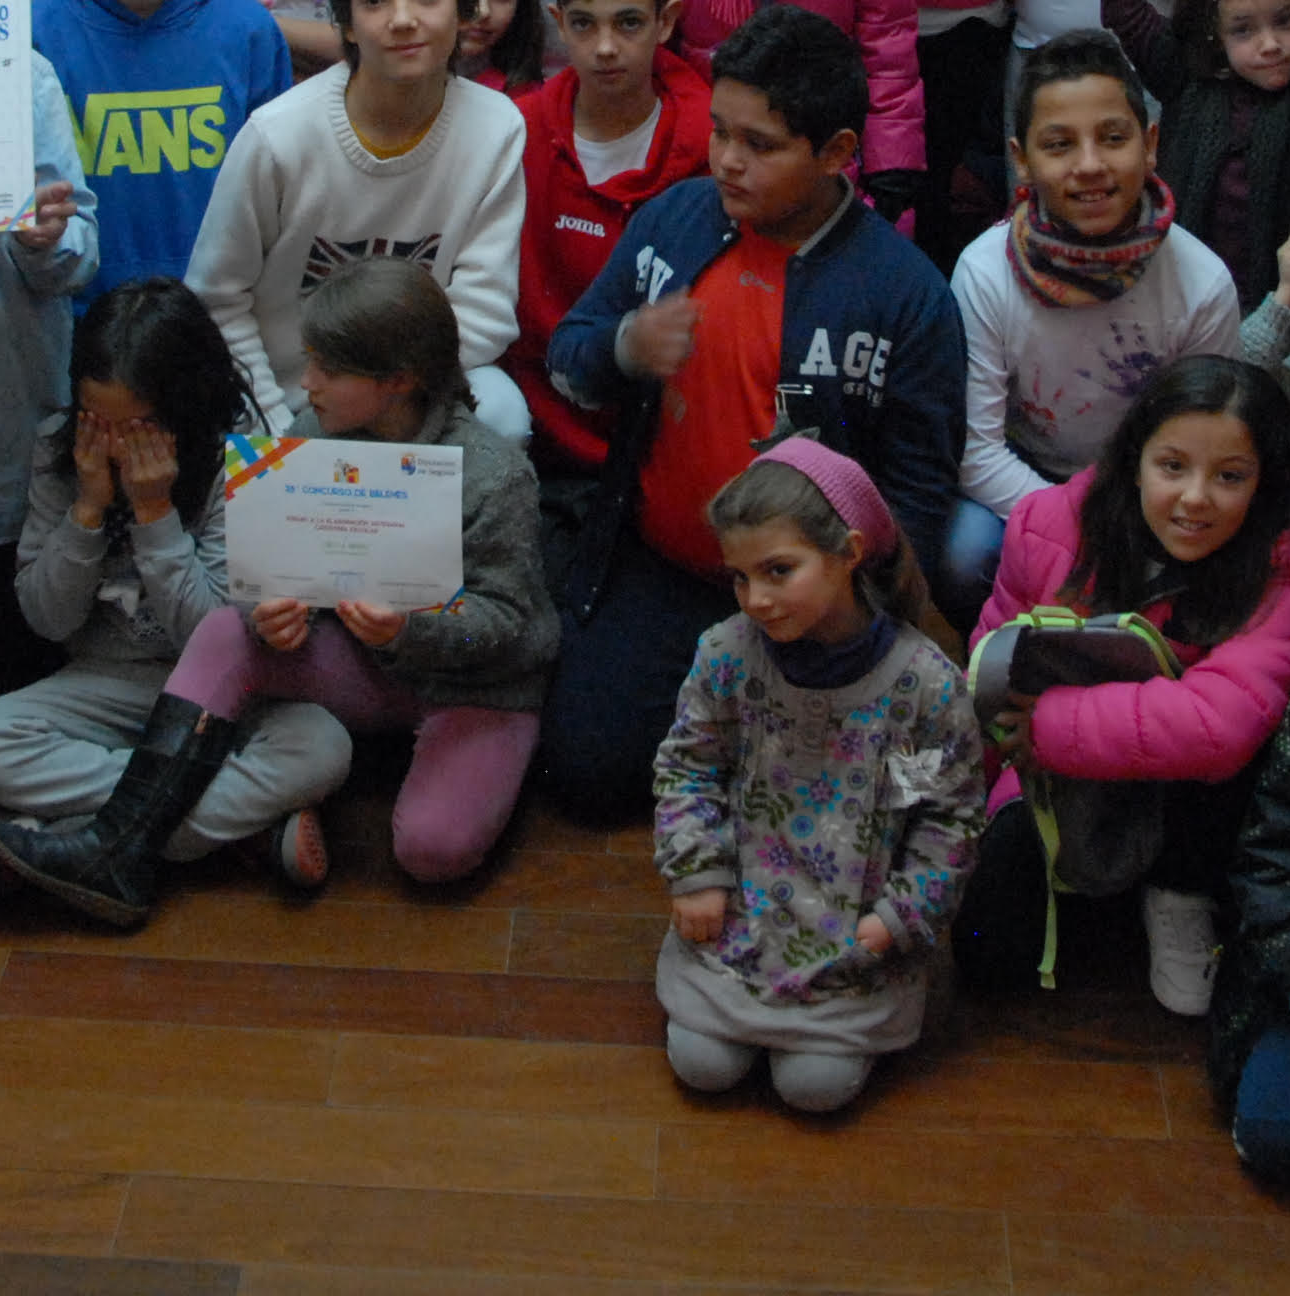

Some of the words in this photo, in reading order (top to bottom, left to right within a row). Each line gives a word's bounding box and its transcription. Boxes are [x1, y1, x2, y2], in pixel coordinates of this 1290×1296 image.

[65, 85, 227, 176] VANS
[798, 327, 893, 388] AGE
[302, 485, 352, 498] CONCURSO
[354, 488, 366, 498] DE
[369, 489, 408, 500] BELENES
